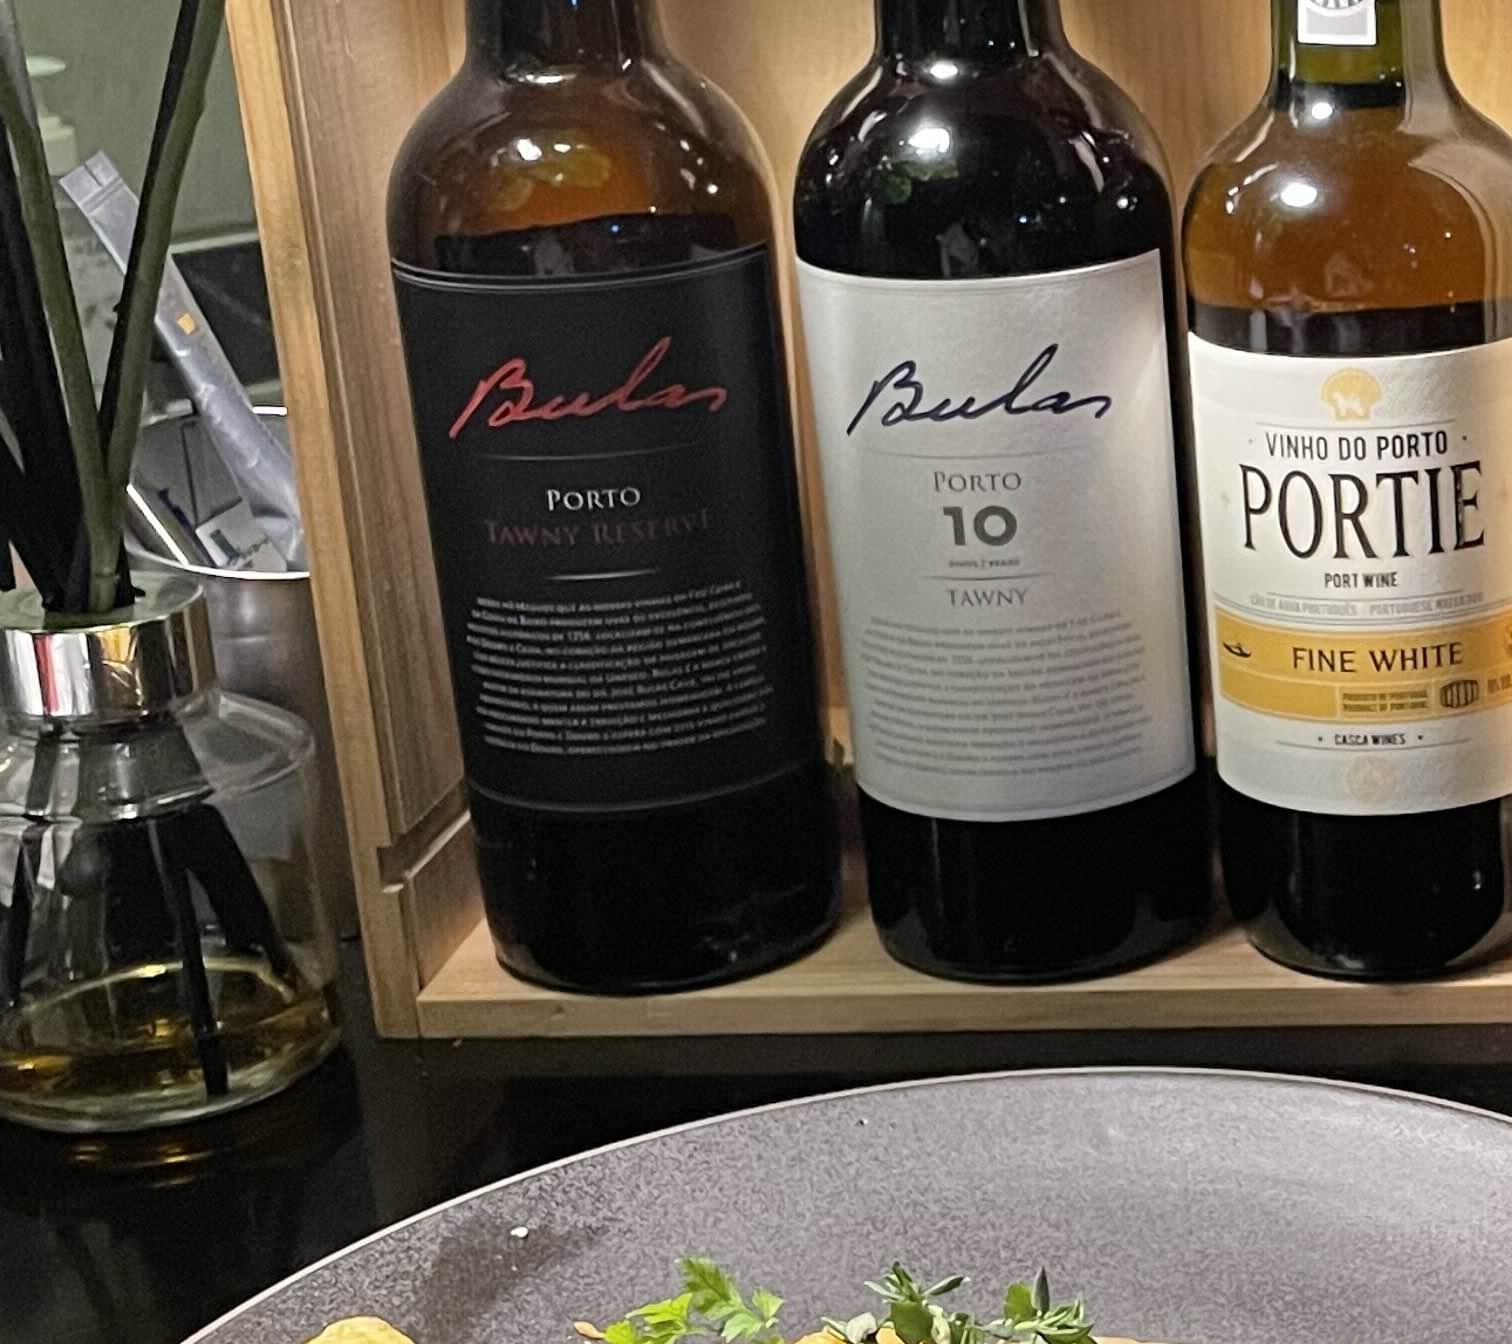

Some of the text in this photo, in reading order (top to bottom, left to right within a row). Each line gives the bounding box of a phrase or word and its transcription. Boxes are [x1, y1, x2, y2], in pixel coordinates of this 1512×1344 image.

[448, 336, 729, 439] Bulas
[845, 342, 1113, 437] Bulas
[1265, 429, 1449, 462] VINHO DO PORTO
[942, 505, 1018, 547] 10
[1239, 460, 1486, 560] PORTIE
[1324, 571, 1398, 589] PORT WINE
[946, 587, 1028, 608] TAWNY
[1292, 641, 1465, 673] FINE WHITE
[1334, 732, 1407, 746] CASCA WINES
